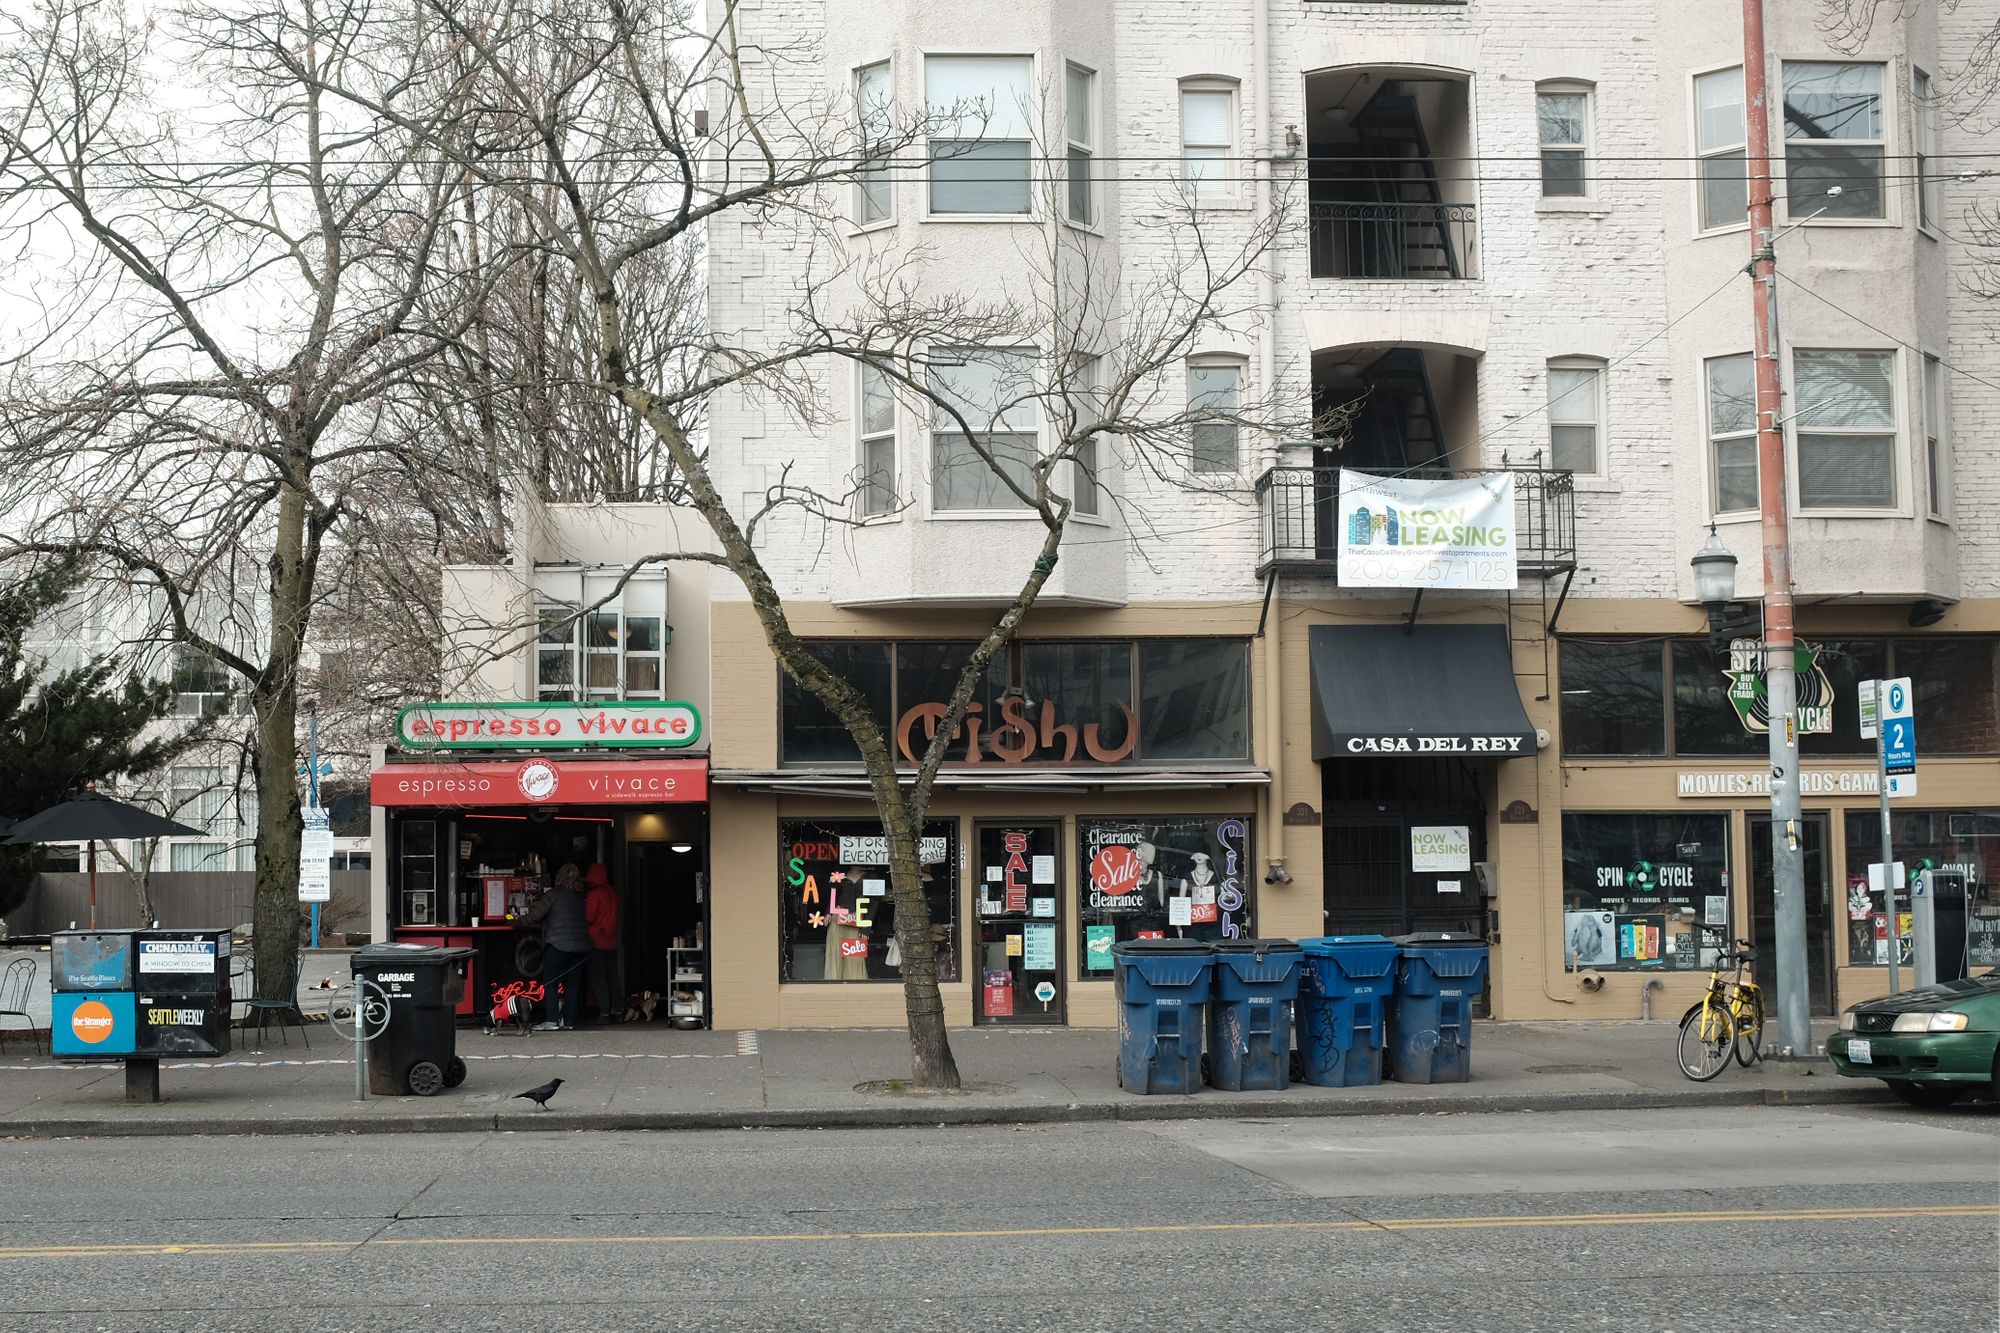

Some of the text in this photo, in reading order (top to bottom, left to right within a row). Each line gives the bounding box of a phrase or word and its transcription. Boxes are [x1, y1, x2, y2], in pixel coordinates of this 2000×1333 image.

[1400, 508, 1465, 526] NOW
[1401, 525, 1507, 547] LEASING
[1347, 559, 1508, 582] 206-257-1125
[1737, 682, 1752, 690] SELL
[1741, 674, 1755, 682] BUY
[1733, 690, 1755, 699] TRADE
[1892, 690, 1901, 708] P
[412, 711, 688, 741] espresso vivace
[1797, 707, 1830, 731] YCLE
[1347, 736, 1523, 753] CASA DEL REY
[1893, 723, 1904, 749] 2
[398, 775, 676, 797] espresso vivace
[1679, 773, 1878, 793] MOVIES RERDS GAM
[843, 836, 888, 848] STOR
[1089, 829, 1143, 845] Clearance
[1413, 834, 1445, 844] NOW
[791, 842, 839, 860] OPEN
[843, 849, 889, 863] EVERYT
[1414, 844, 1468, 855] LEASING
[1004, 832, 1028, 911] SALE
[1099, 850, 1139, 890] Sale
[1597, 867, 1693, 887] SPIN CYCLE
[1089, 892, 1143, 907] Clearance
[842, 940, 866, 955] Sale
[80, 974, 98, 982] Seattle
[378, 973, 415, 982] GARBAGE
